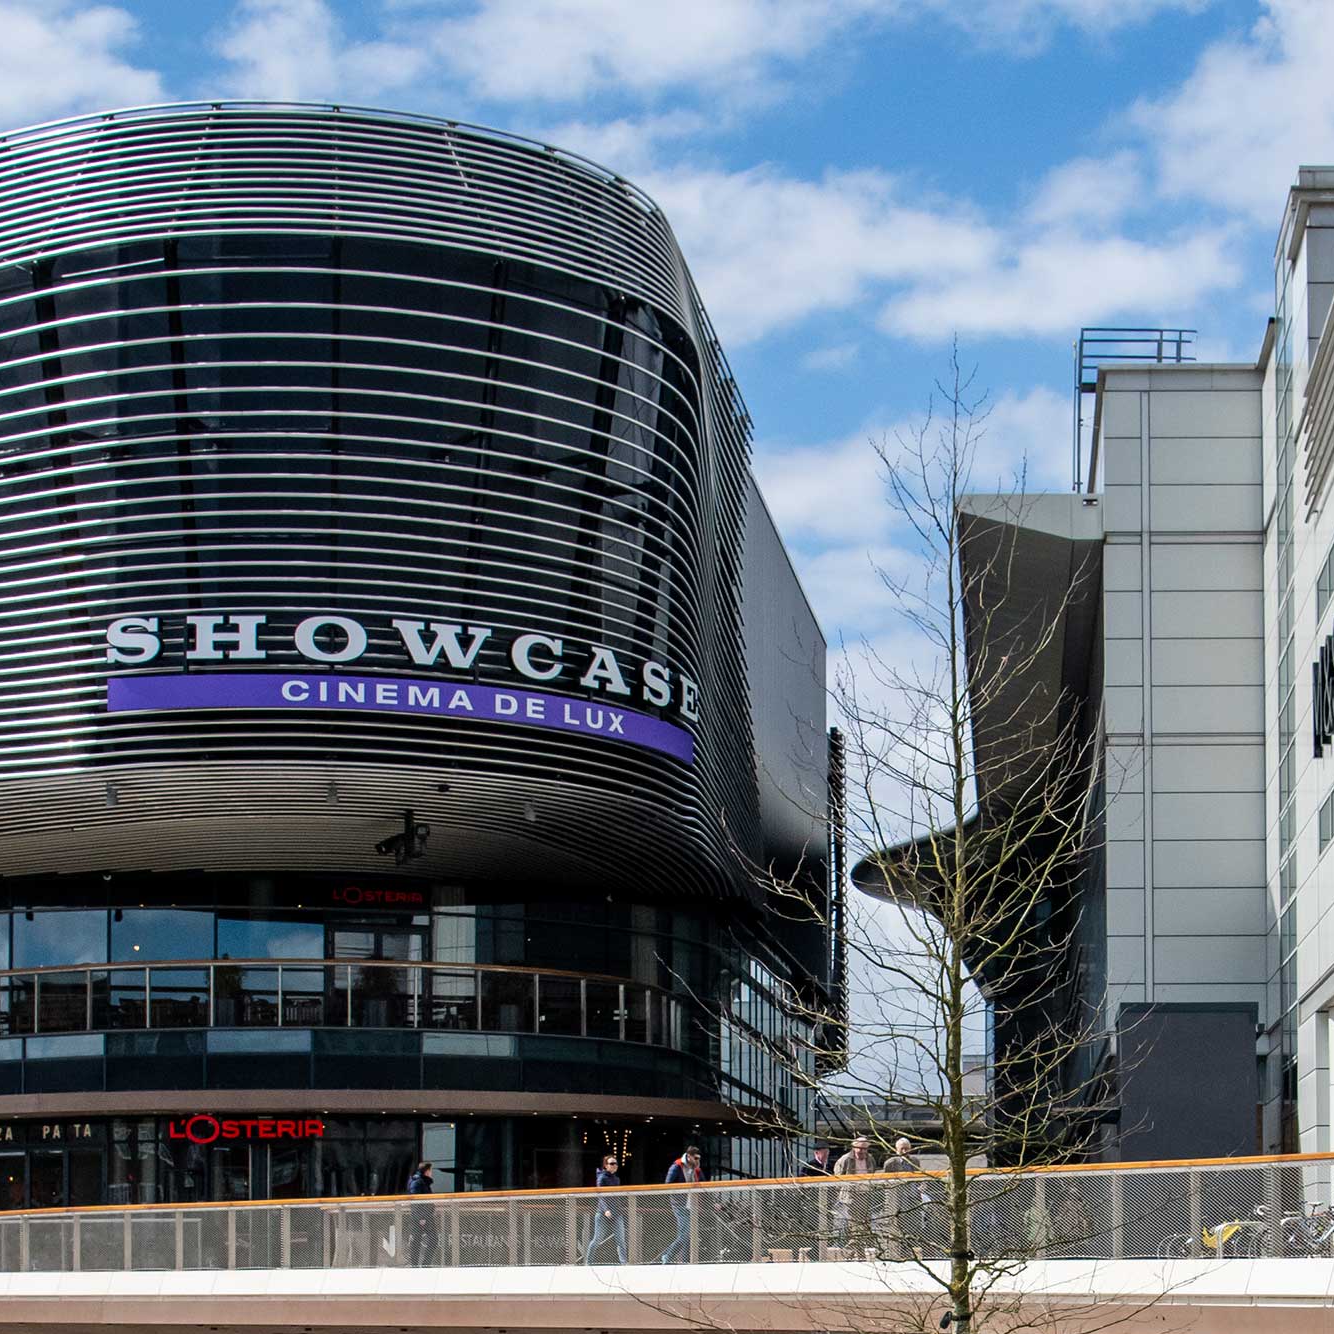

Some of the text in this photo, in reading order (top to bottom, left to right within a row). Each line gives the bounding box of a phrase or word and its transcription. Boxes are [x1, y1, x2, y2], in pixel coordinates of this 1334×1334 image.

[106, 614, 701, 723] SHOWCASE
[280, 679, 626, 736] CINEMA DE LUX
[169, 1114, 324, 1145] L'OSTERIA
